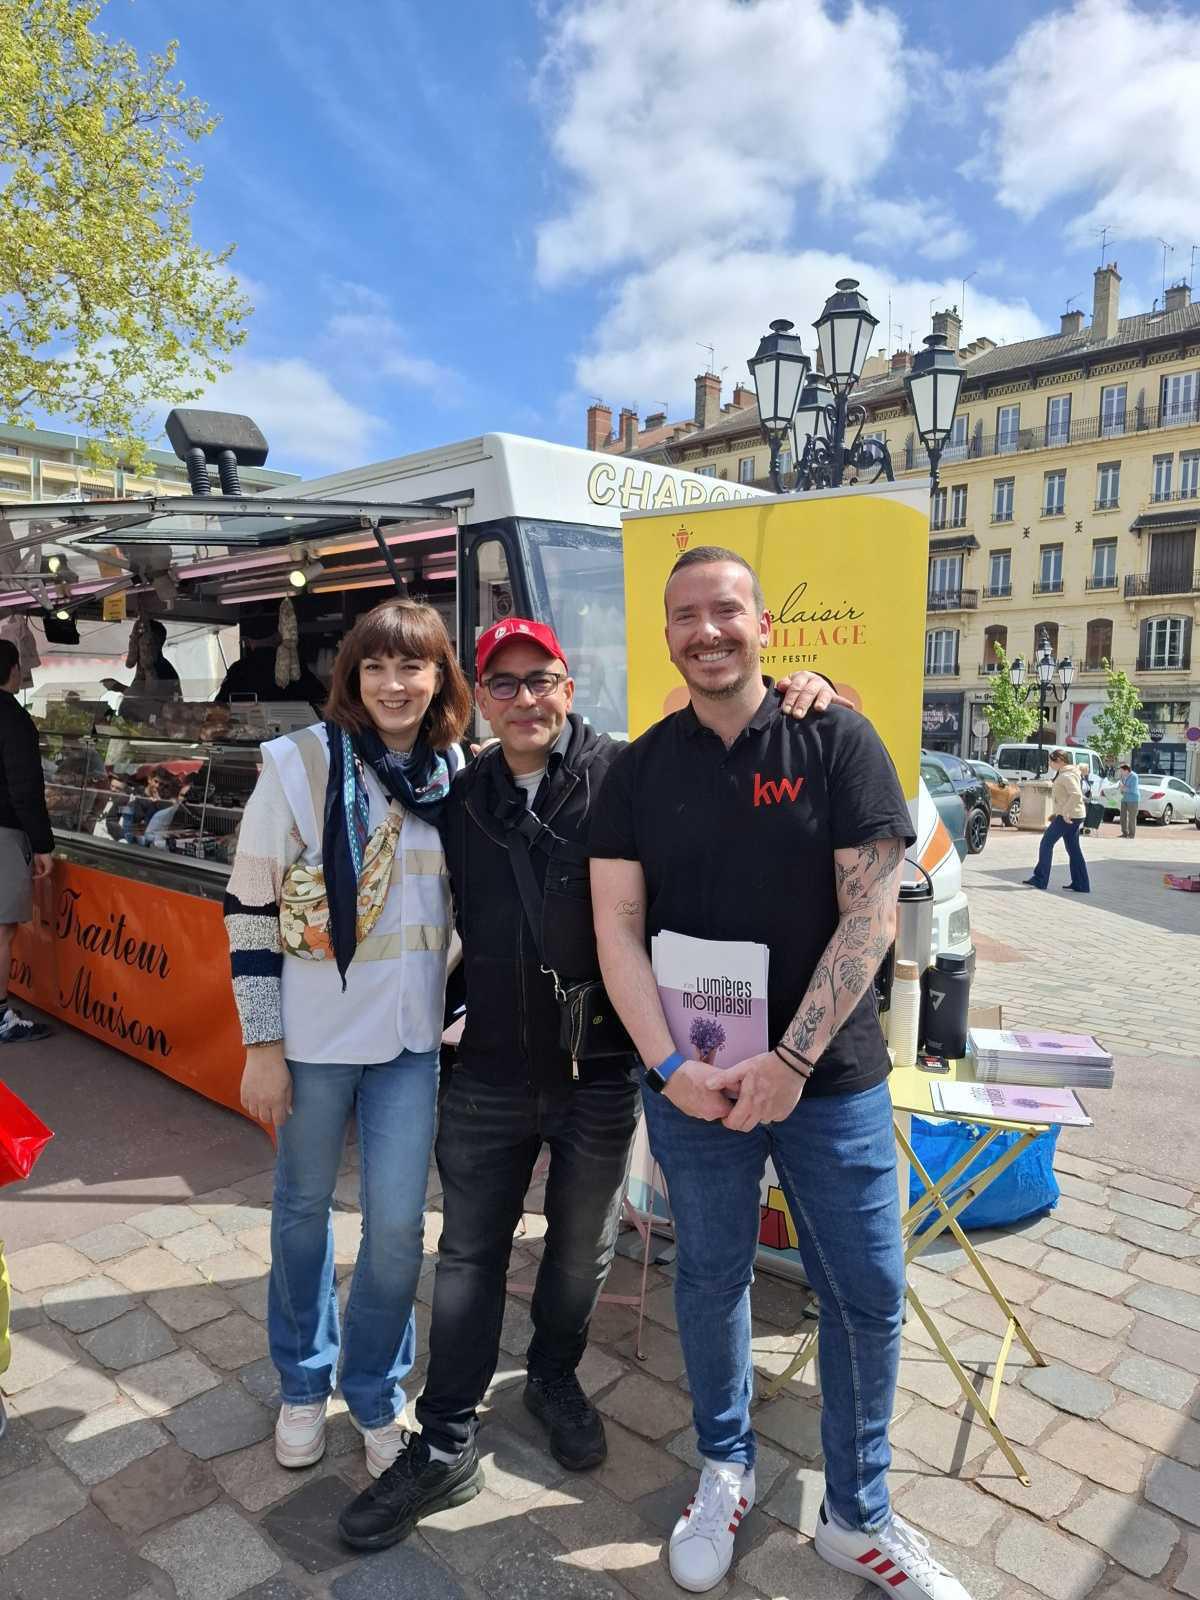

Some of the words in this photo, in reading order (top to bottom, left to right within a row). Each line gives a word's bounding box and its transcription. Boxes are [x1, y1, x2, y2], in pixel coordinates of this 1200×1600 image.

[767, 582, 865, 624] laisir
[771, 624, 867, 648] ILLAGE
[782, 654, 818, 663] FESTIF
[56, 888, 170, 980] Traiteur
[59, 965, 173, 1057] Maison
